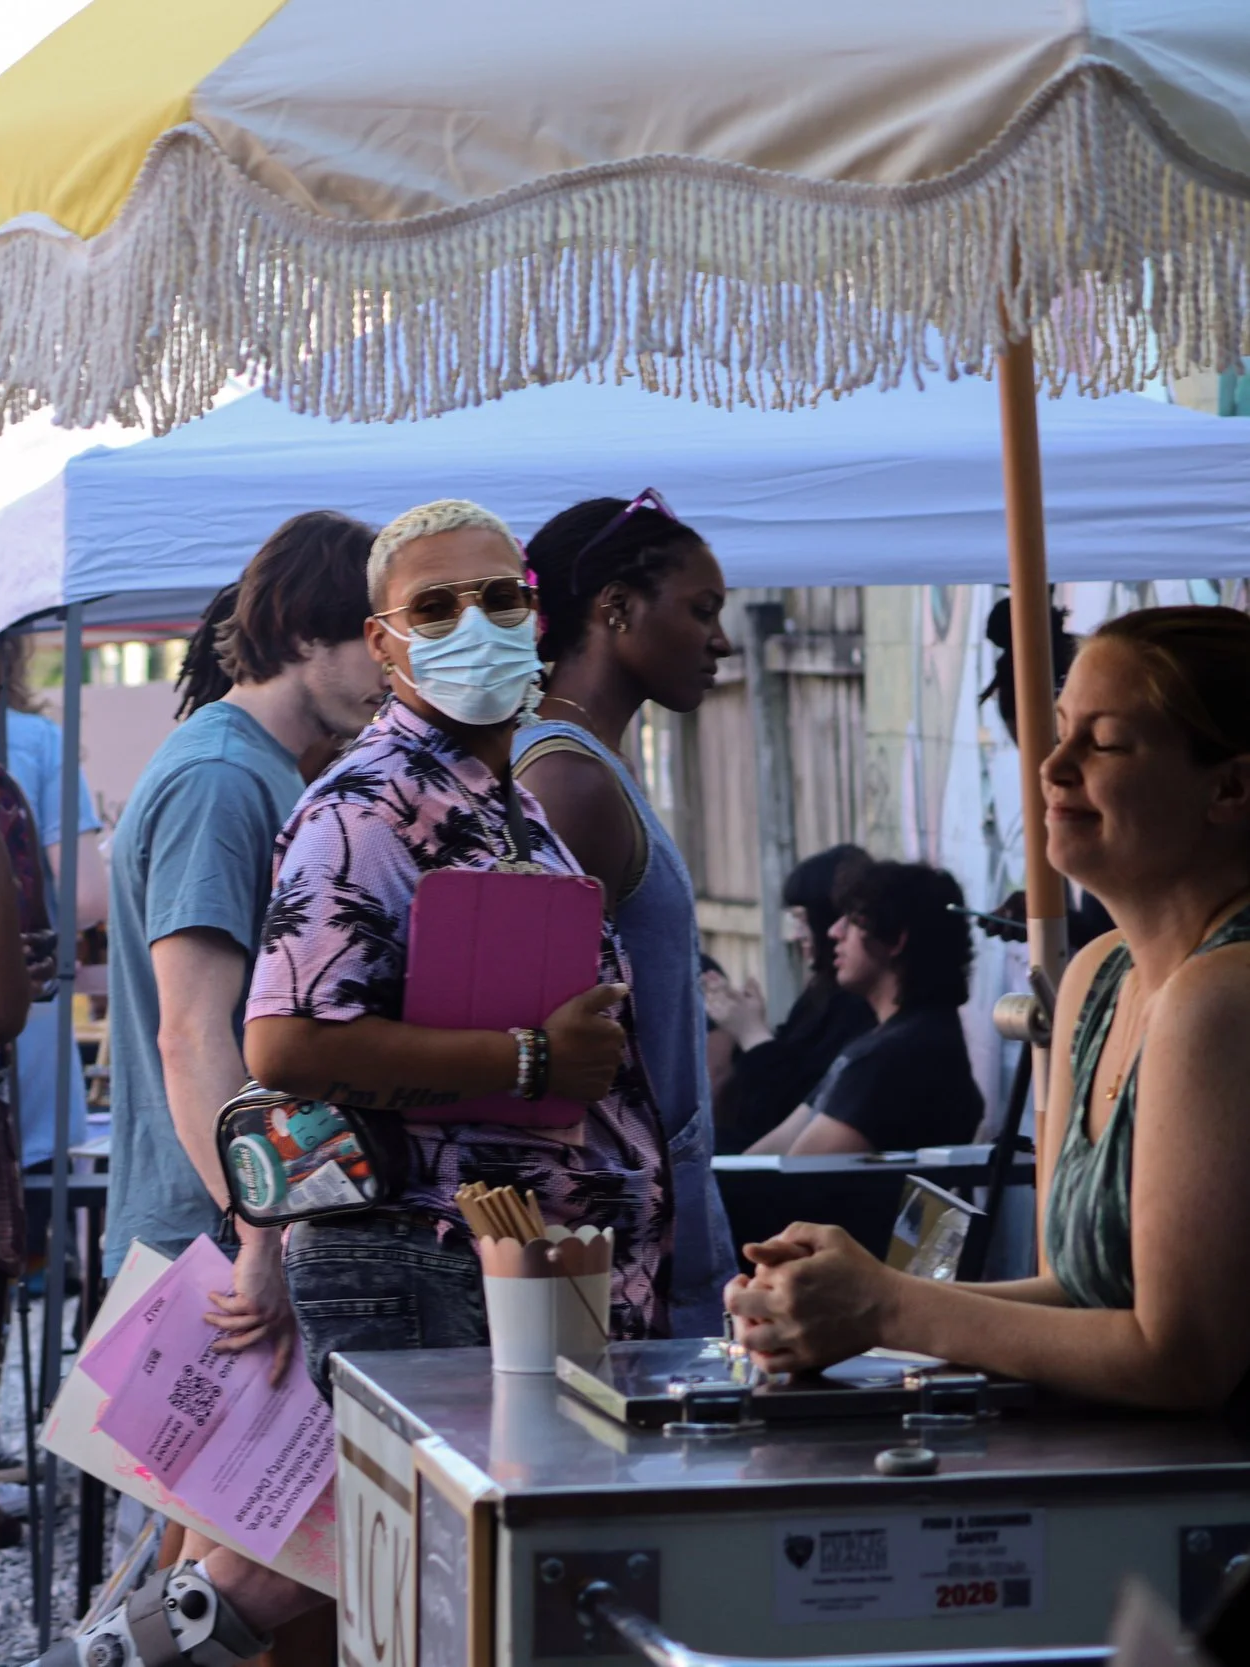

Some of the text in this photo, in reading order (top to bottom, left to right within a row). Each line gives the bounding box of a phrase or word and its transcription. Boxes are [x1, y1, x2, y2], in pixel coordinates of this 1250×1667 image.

[265, 1416, 314, 1479] Community
[305, 1414, 333, 1448] wards
[234, 1477, 271, 1521] Defense
[269, 1432, 336, 1529] gional Resources
[936, 1581, 998, 1608] 2026
